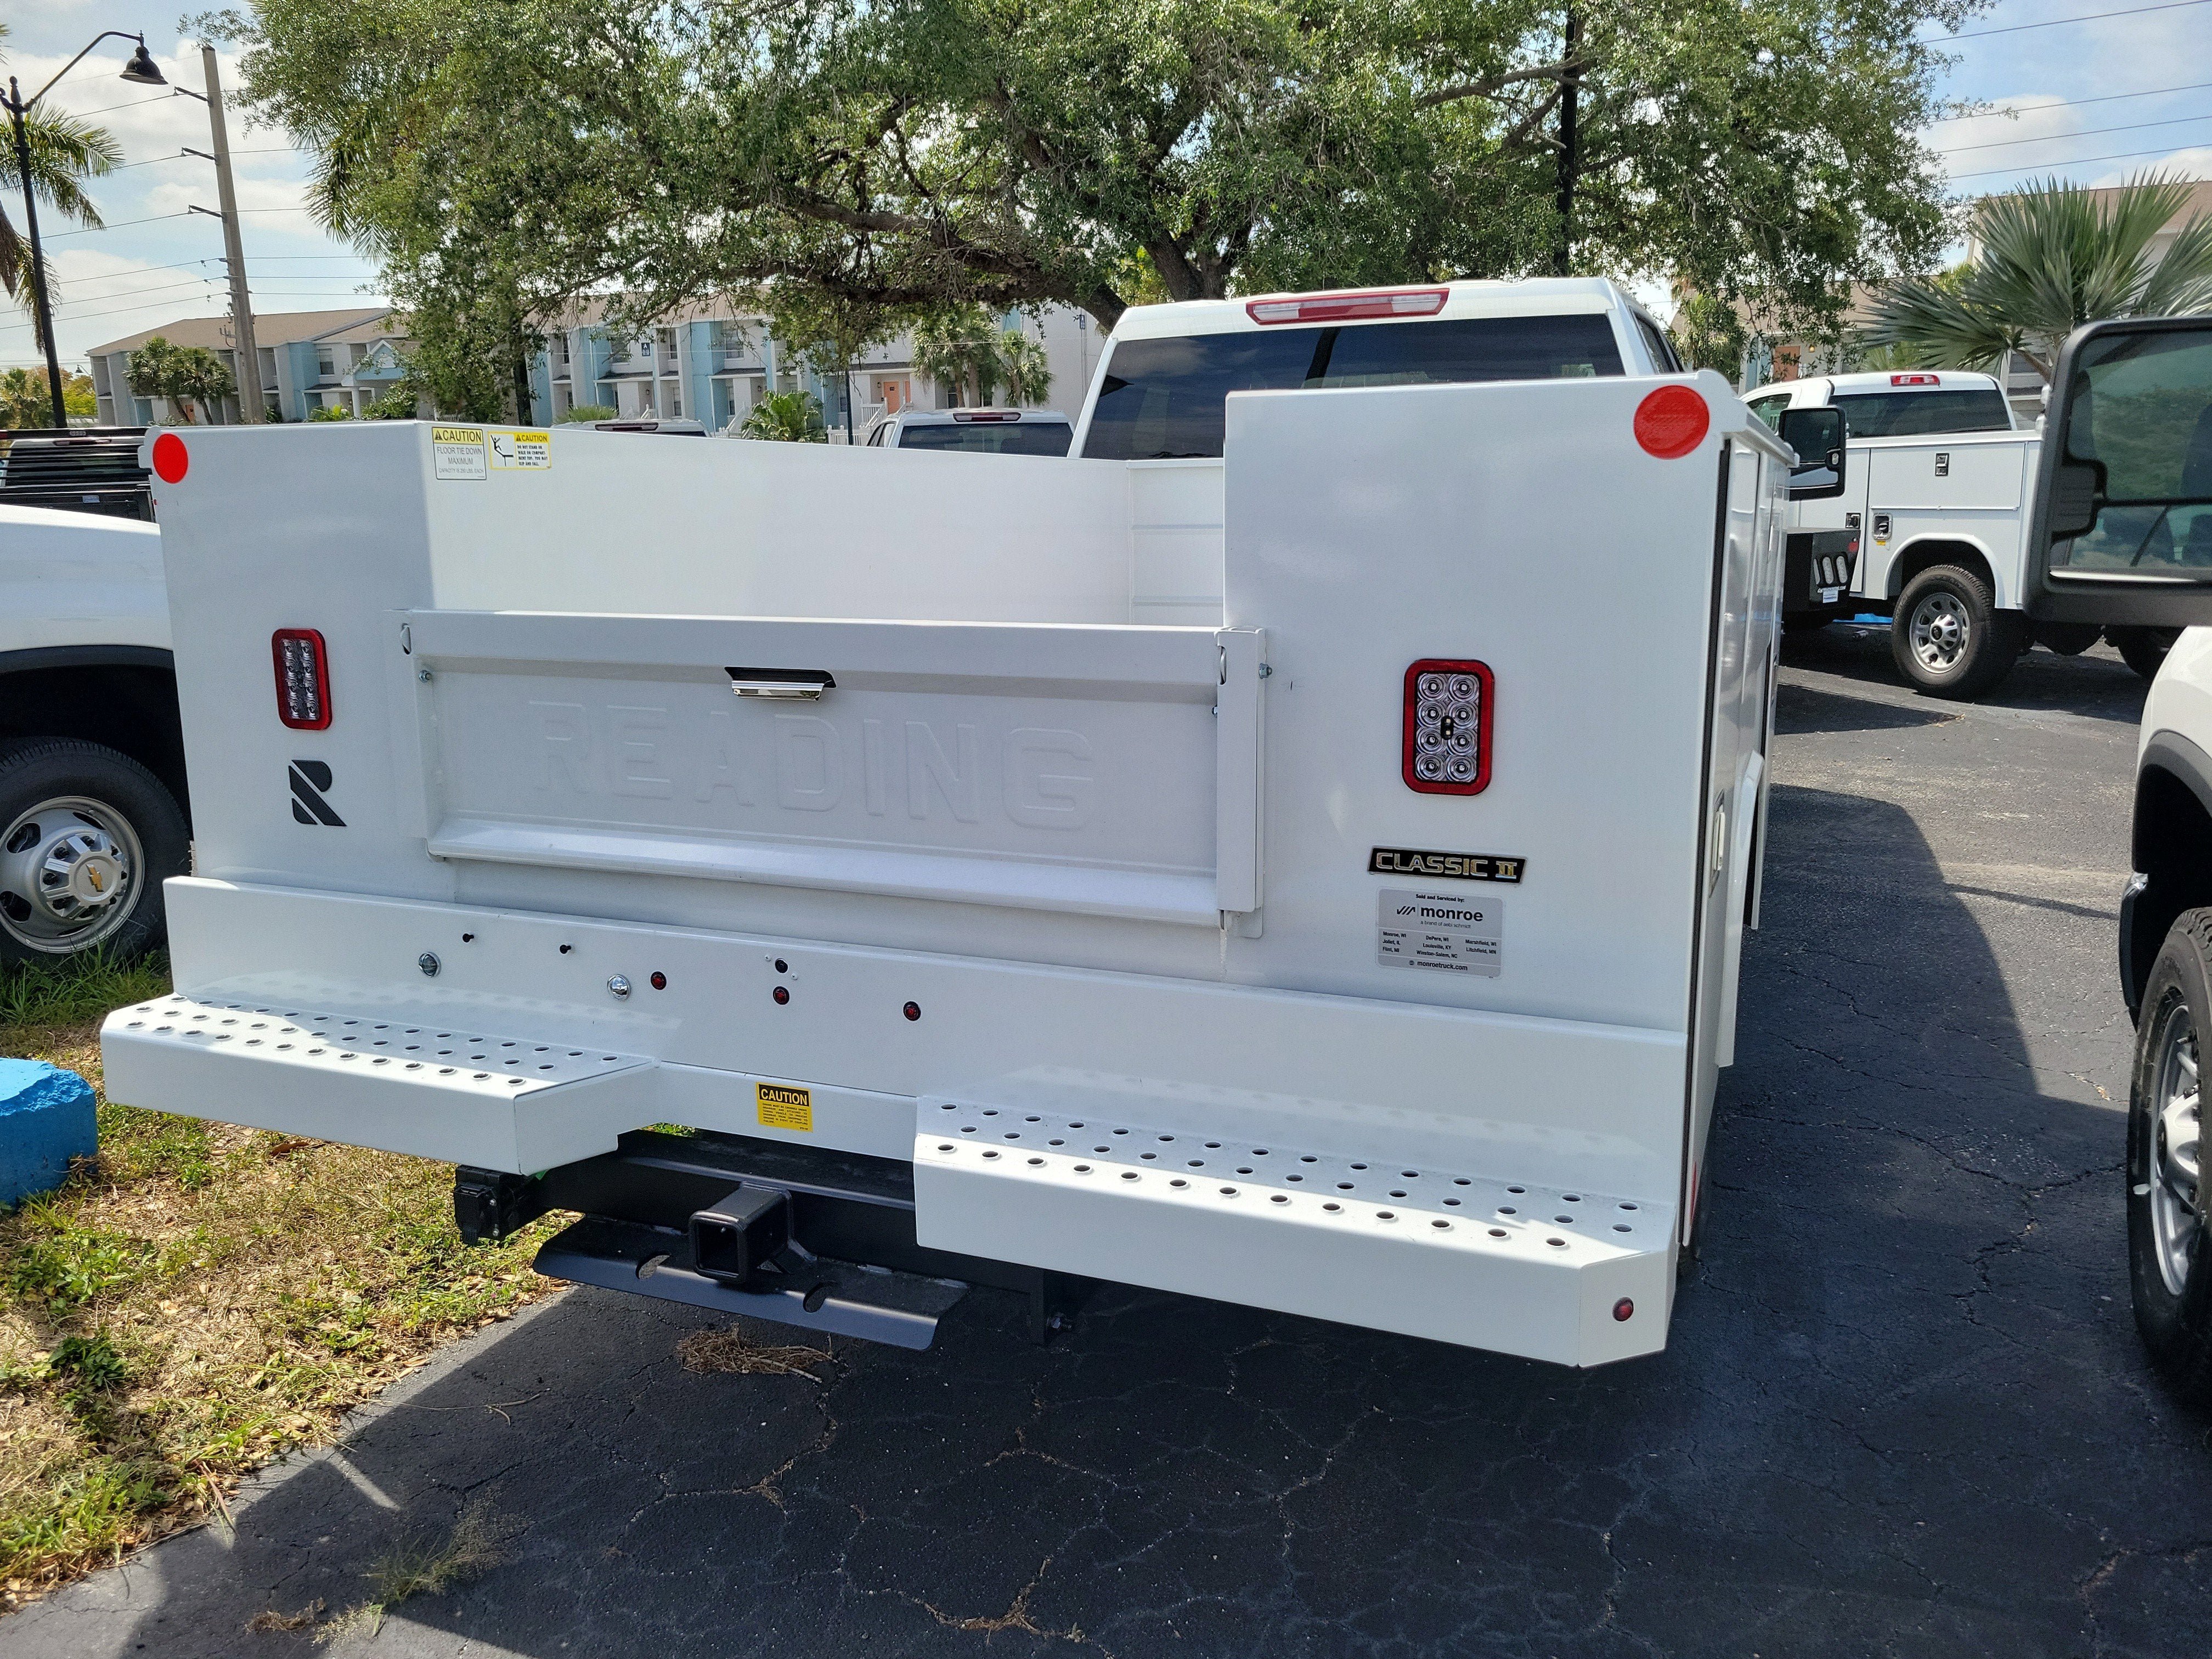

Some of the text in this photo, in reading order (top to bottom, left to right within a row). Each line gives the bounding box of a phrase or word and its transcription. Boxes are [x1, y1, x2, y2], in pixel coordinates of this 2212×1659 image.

[443, 430, 482, 442] CAUTION
[527, 700, 1095, 832] READING
[1376, 852, 1517, 879] CLASSIC II
[1420, 907, 1483, 922] monroe
[1417, 961, 1468, 970] monroetruck.com
[761, 1088, 808, 1105] CAUTION
